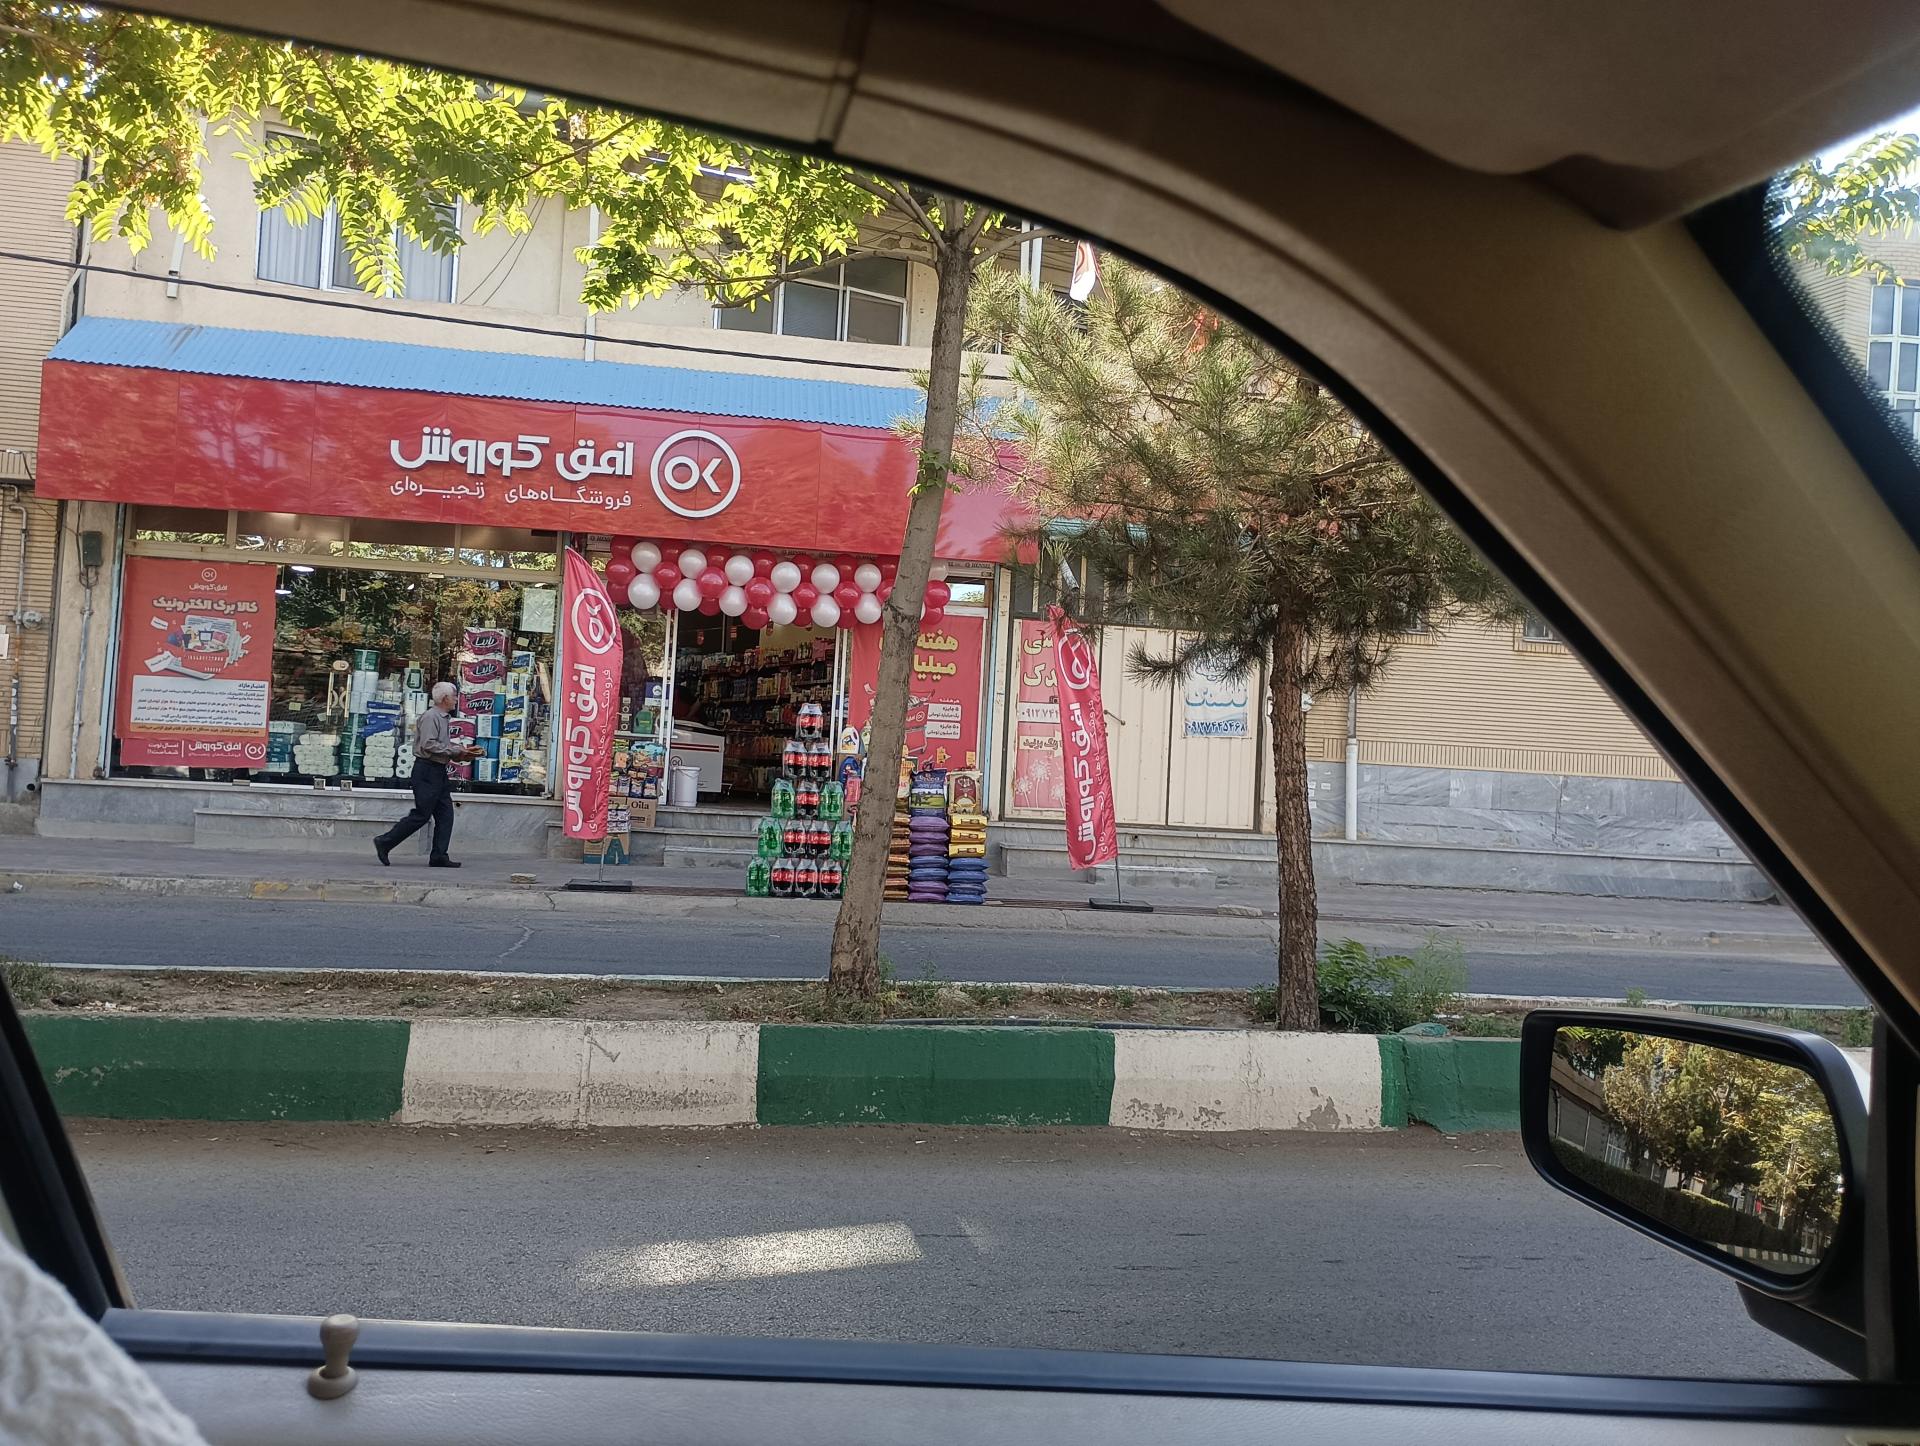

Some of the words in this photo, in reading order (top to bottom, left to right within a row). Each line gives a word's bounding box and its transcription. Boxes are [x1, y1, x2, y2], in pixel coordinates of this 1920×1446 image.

[390, 426, 550, 477] کوروش
[555, 439, 635, 481] افق
[152, 596, 212, 612] الکترونیک
[917, 629, 958, 651] هفته
[914, 654, 957, 681] میلیا
[569, 663, 598, 722] افق
[188, 741, 224, 752] کوروش
[1069, 703, 1090, 756] افق
[223, 742, 241, 752] افق
[565, 718, 594, 832] کوروش
[631, 800, 649, 809] Oila
[1074, 757, 1096, 861] کوروش
